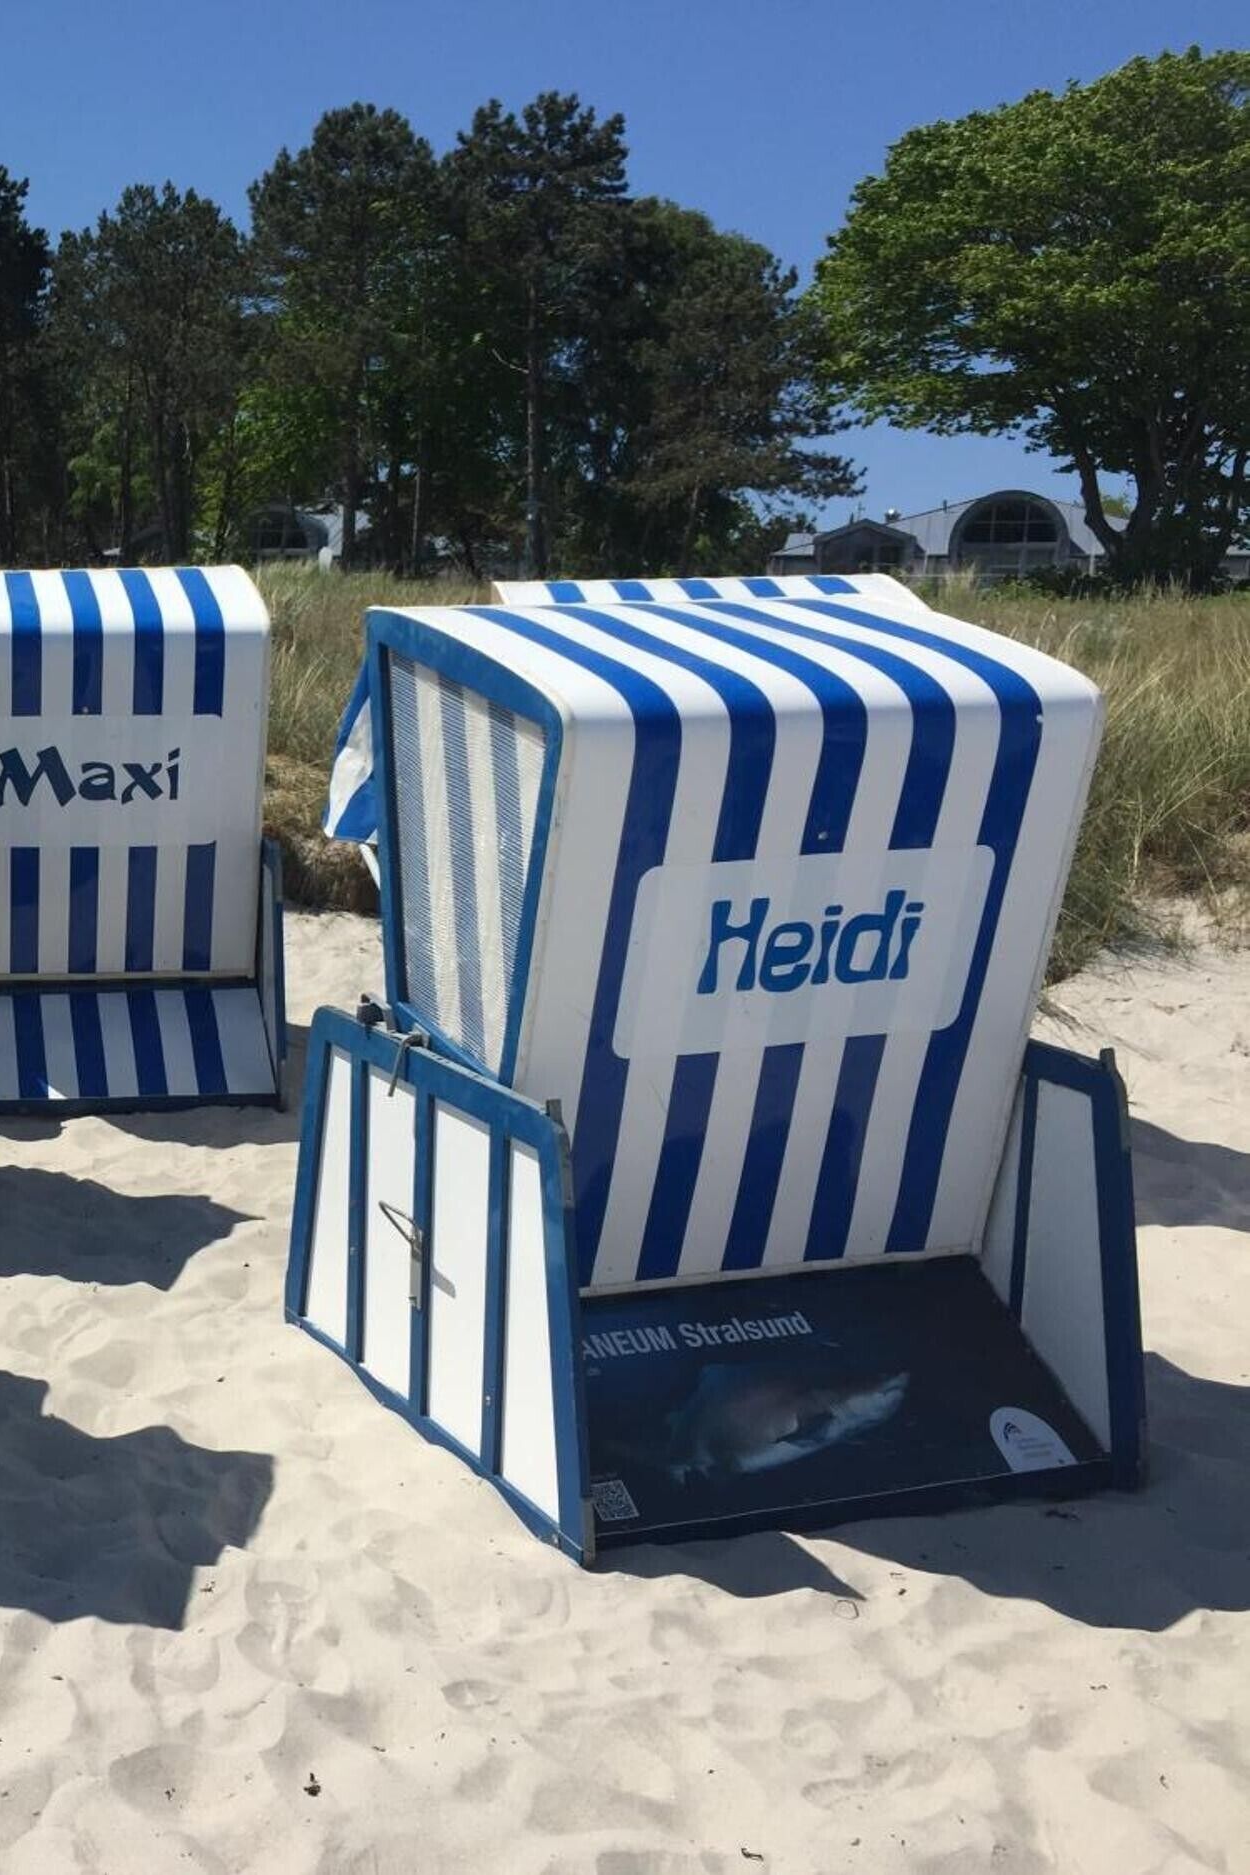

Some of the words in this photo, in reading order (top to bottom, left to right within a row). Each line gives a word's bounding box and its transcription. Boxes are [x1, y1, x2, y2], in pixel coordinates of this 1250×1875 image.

[696, 889, 925, 994] Heidi
[581, 1326, 677, 1359] ANEUM
[677, 1312, 812, 1348] Stralsund
